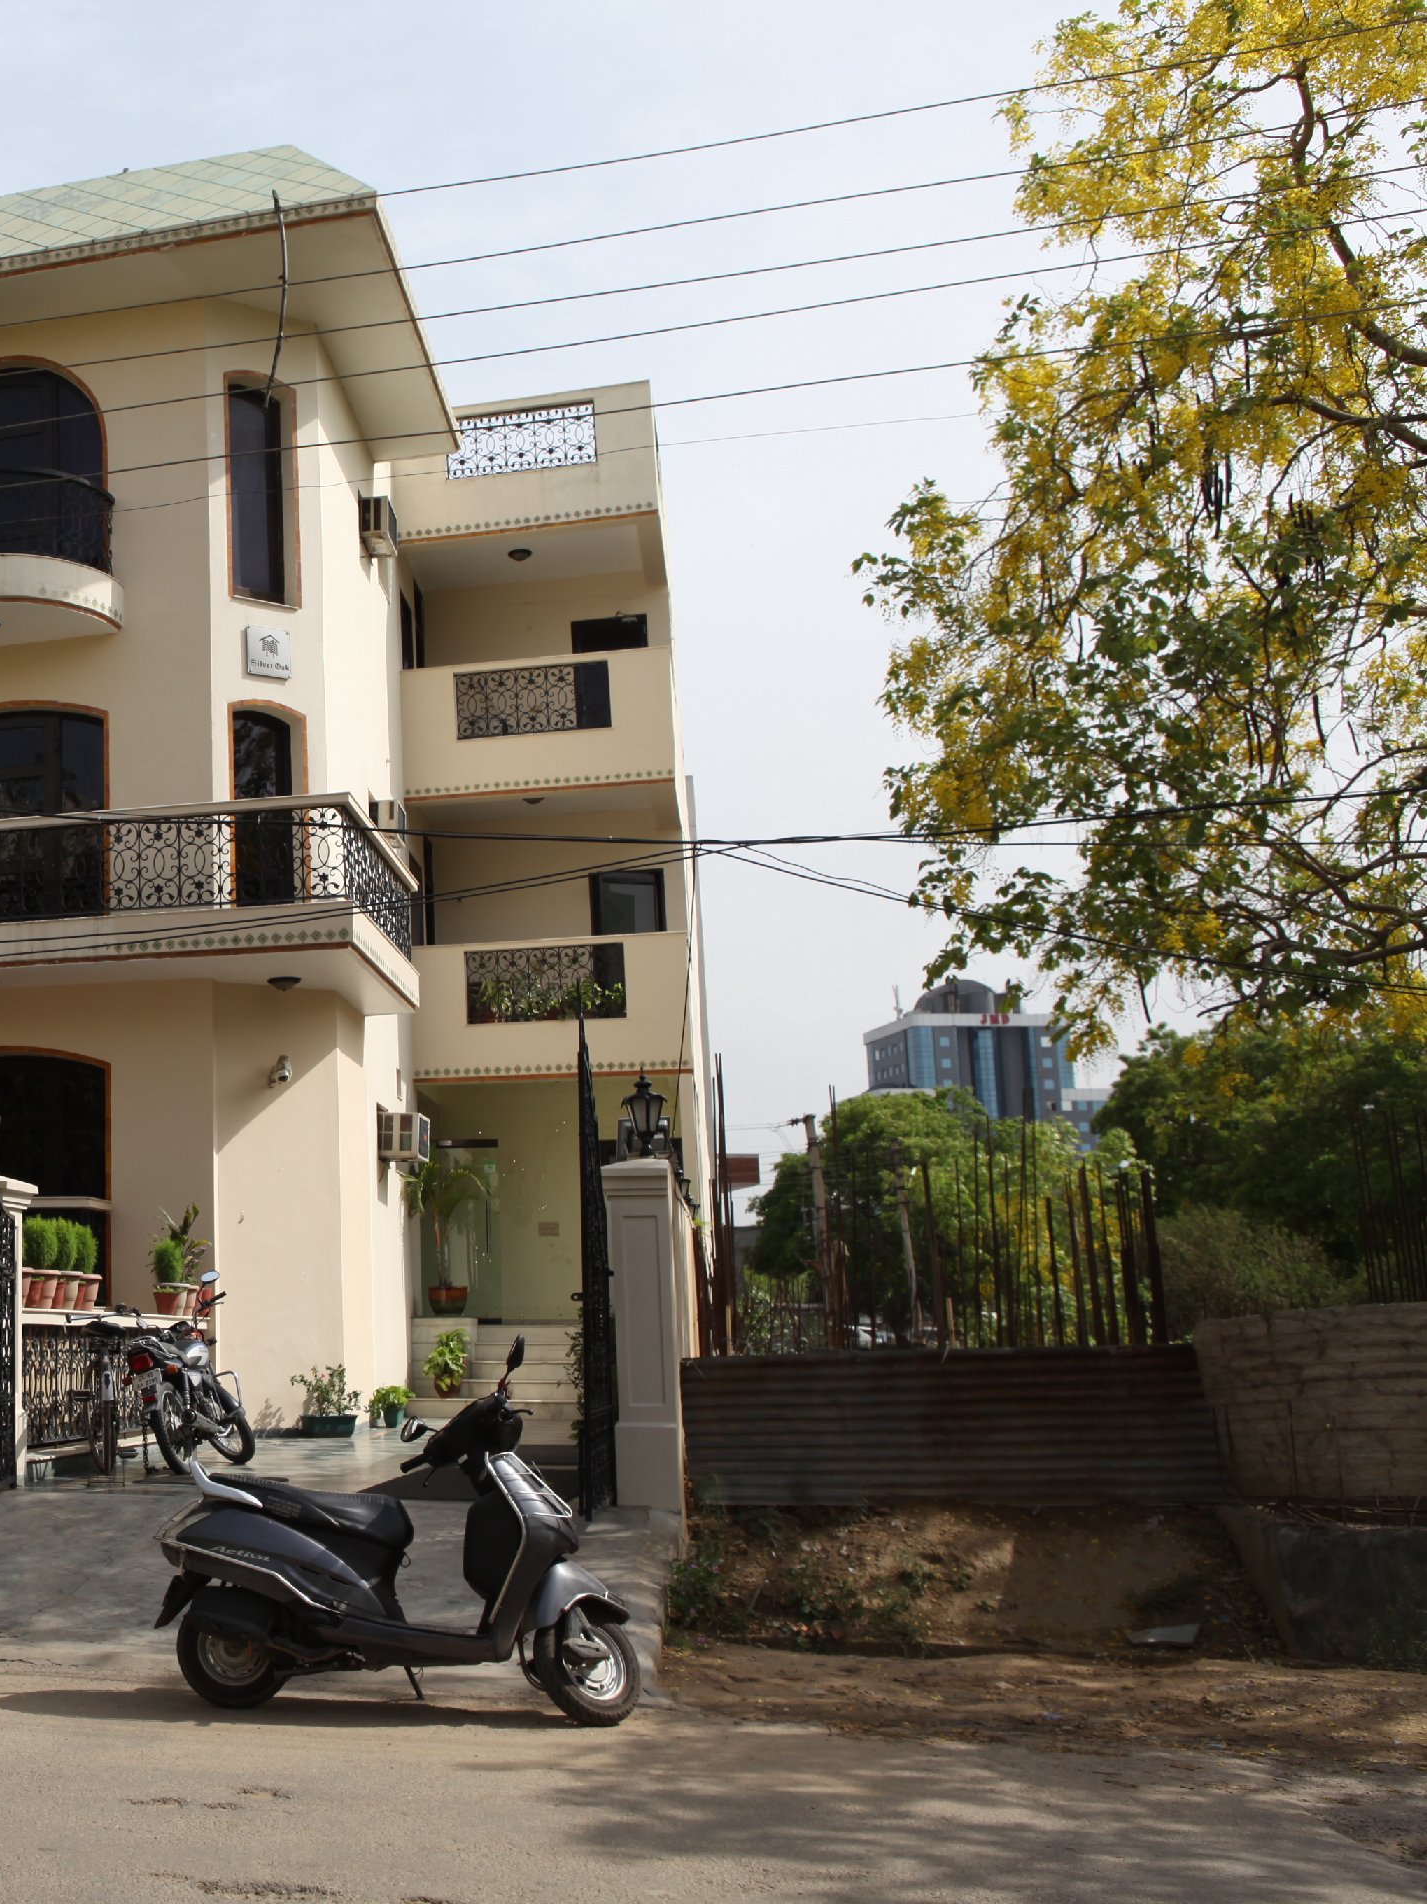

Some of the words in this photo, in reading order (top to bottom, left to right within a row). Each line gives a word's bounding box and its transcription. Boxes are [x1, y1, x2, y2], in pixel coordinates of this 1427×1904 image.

[250, 658, 273, 669] Silver
[274, 662, 290, 671] Oak
[209, 1545, 271, 1562] Activa
